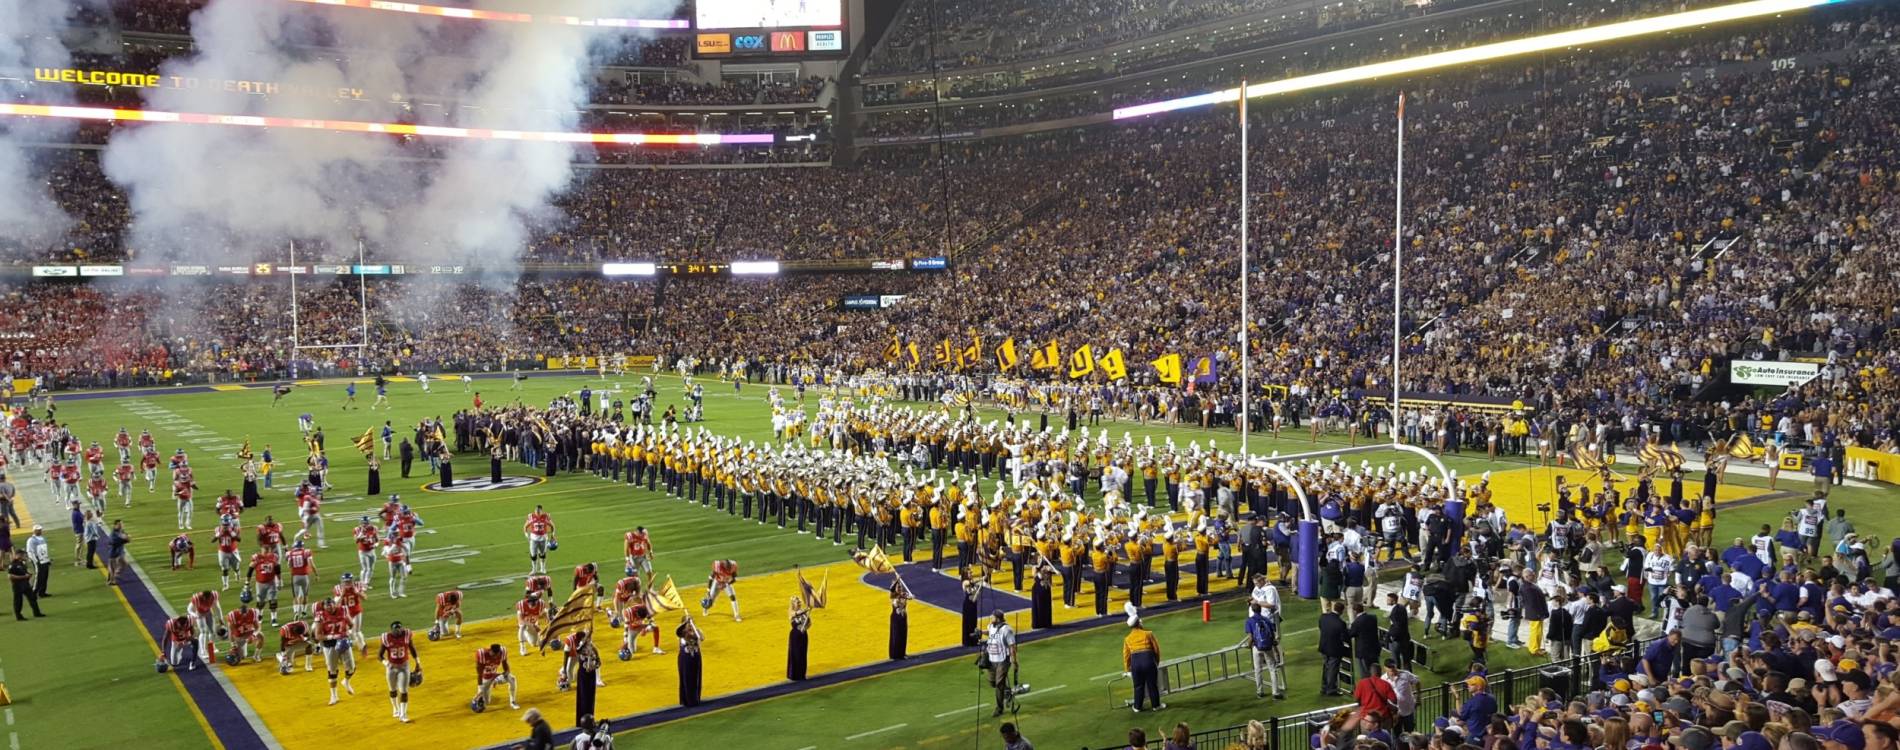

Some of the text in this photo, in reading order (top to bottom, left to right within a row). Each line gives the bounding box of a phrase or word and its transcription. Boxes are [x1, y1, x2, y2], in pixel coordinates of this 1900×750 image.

[1771, 57, 1796, 71] 105
[34, 67, 161, 88] WELCOME
[170, 75, 199, 89] TO
[208, 79, 280, 95] DEATH
[1776, 368, 1816, 376] Insurance
[327, 622, 345, 634] 77
